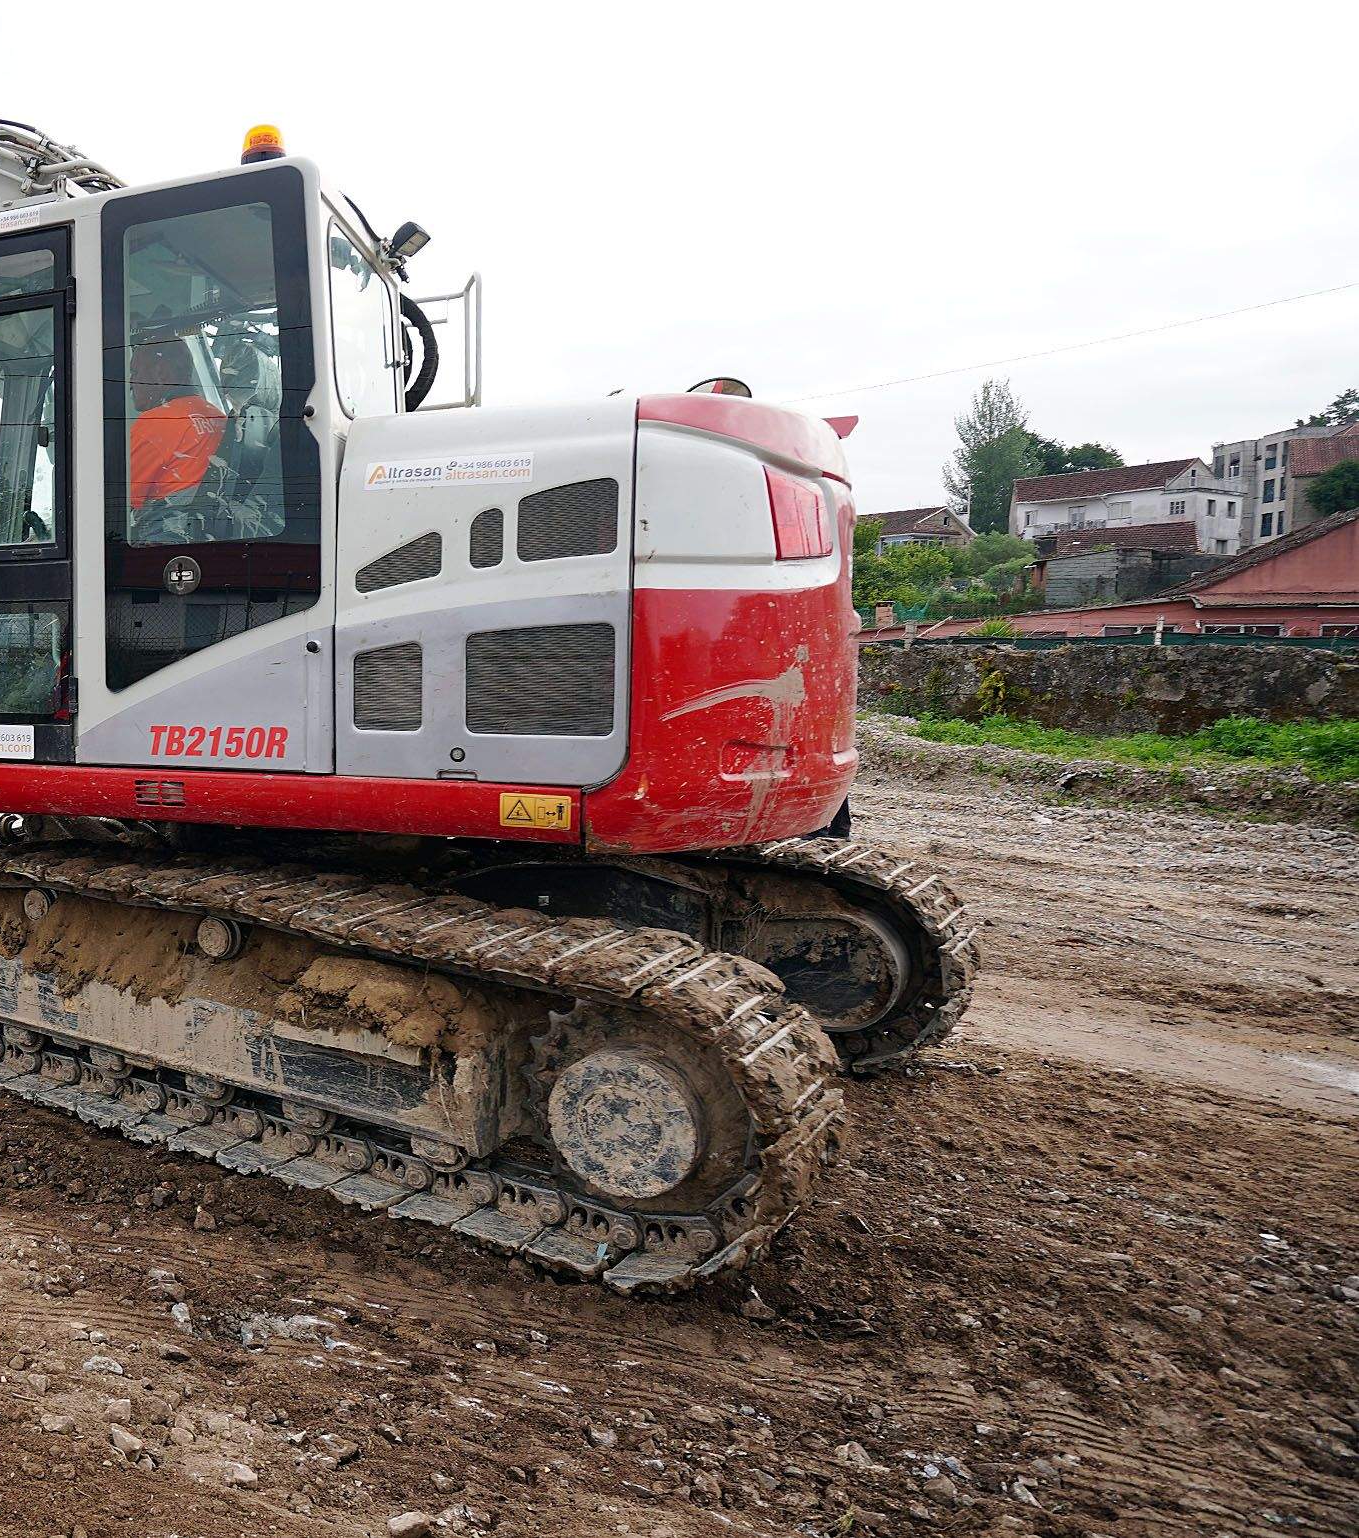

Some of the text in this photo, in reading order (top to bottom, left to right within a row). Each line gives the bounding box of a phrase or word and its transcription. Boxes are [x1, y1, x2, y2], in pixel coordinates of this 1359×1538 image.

[476, 461, 493, 469] 986
[495, 460, 512, 468] 603
[514, 458, 531, 467] 619
[368, 465, 442, 485] Altrasan
[445, 468, 531, 481] altrasan.com
[1, 734, 15, 742] 603
[17, 734, 32, 742] 619
[150, 725, 289, 758] TB2150R
